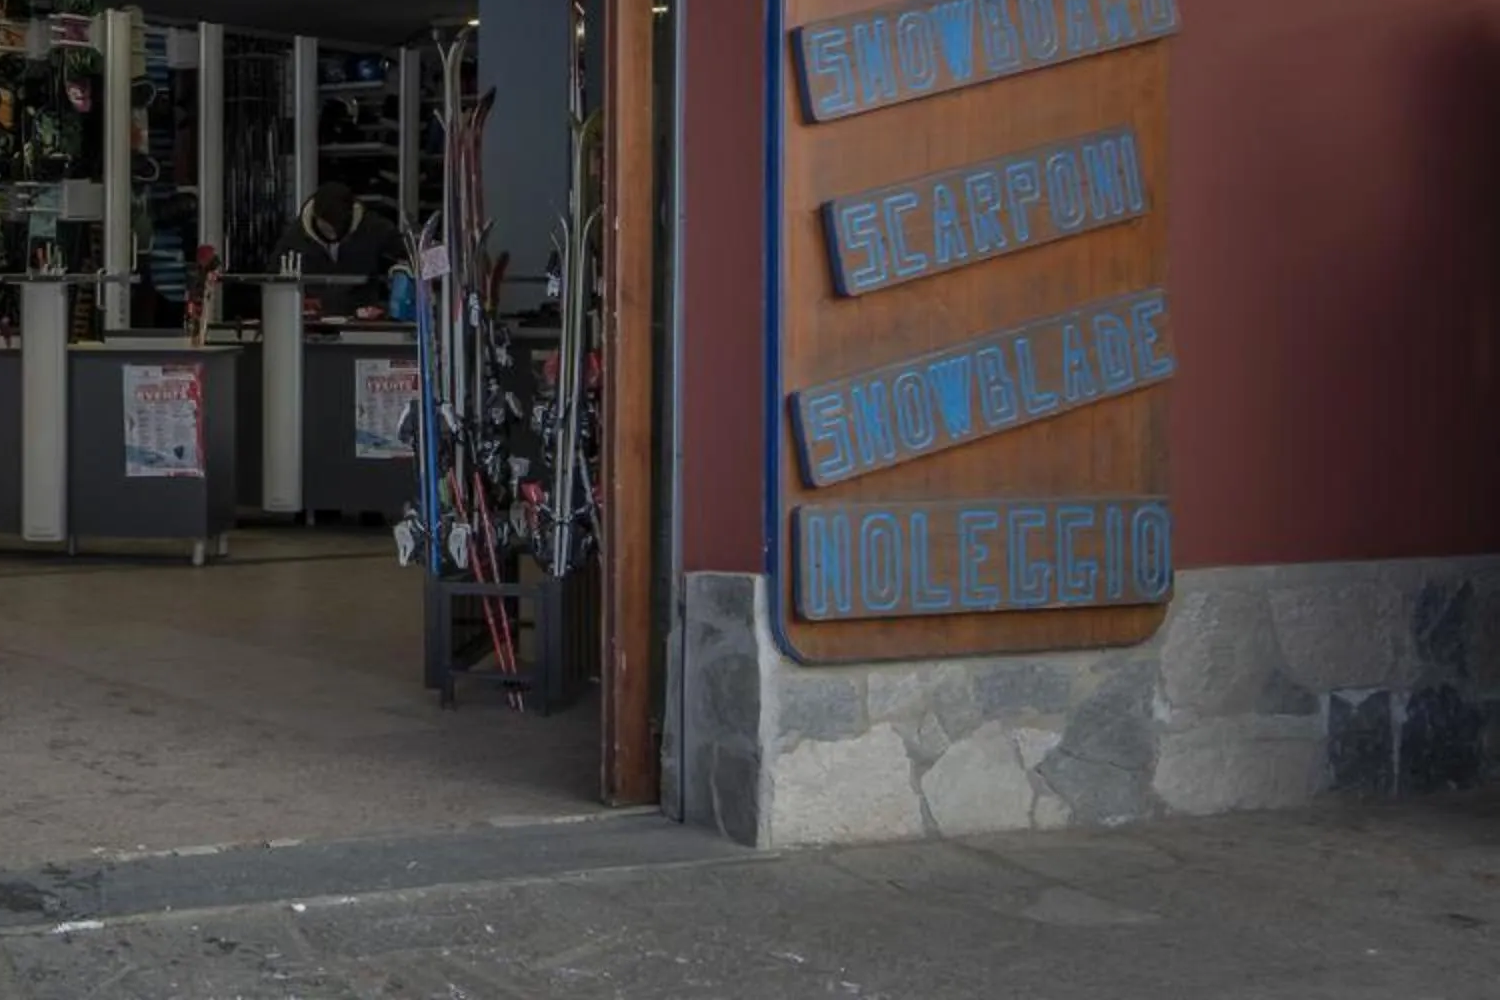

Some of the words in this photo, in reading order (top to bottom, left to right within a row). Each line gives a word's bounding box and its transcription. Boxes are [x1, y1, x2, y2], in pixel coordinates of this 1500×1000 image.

[840, 134, 1143, 288] SCARPONI
[810, 298, 1176, 481] SNOWBLADE
[807, 502, 1172, 614] NOLEGGIO
